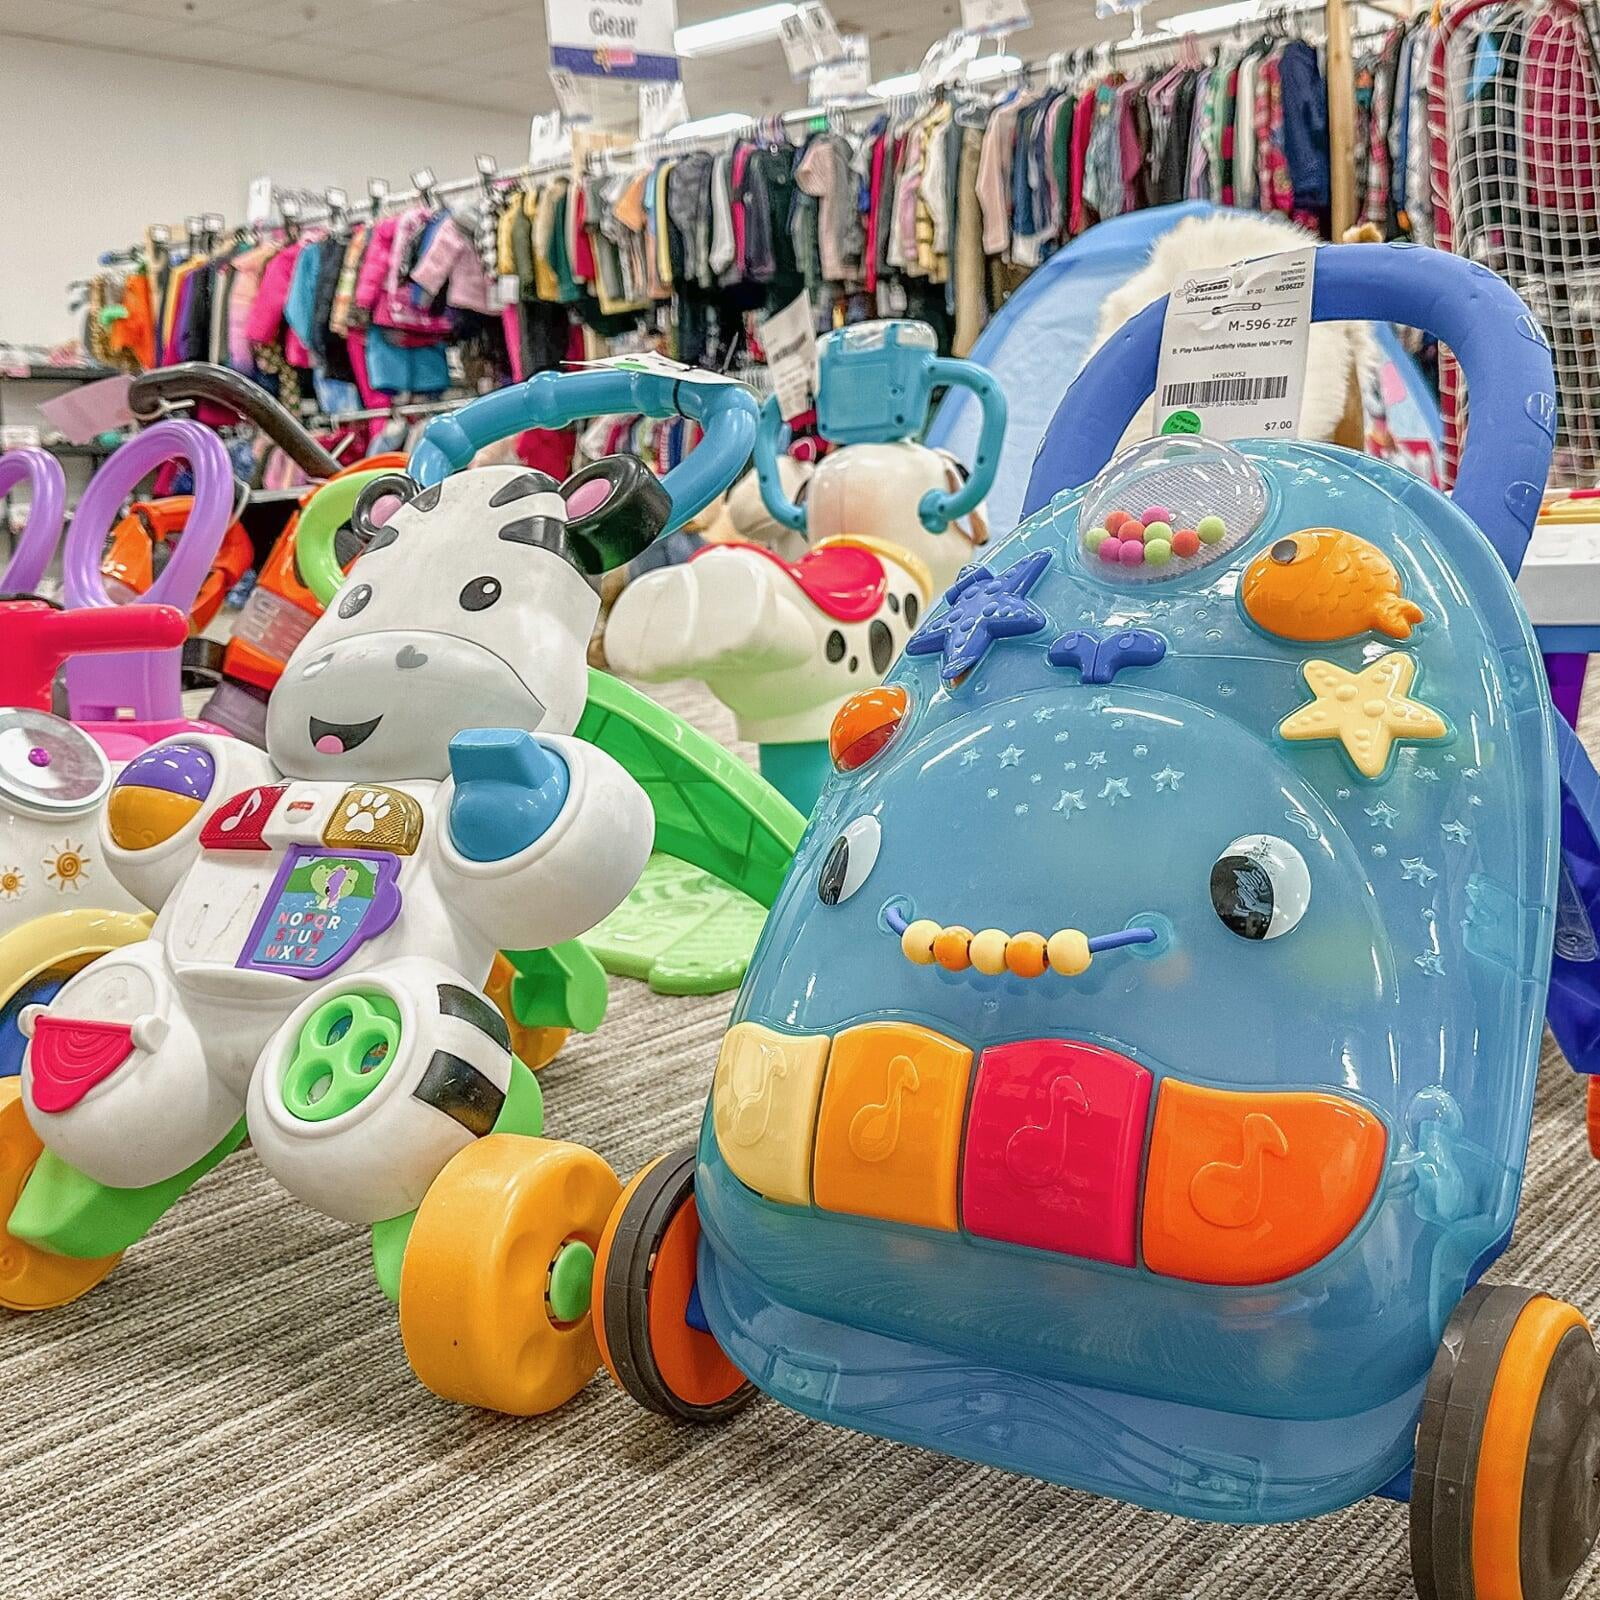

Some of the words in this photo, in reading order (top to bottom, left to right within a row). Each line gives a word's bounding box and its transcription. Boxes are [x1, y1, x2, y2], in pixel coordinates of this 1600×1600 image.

[589, 8, 637, 38] Gear
[1228, 317, 1298, 331] M-596-ZZF
[1264, 420, 1293, 431] $7.00
